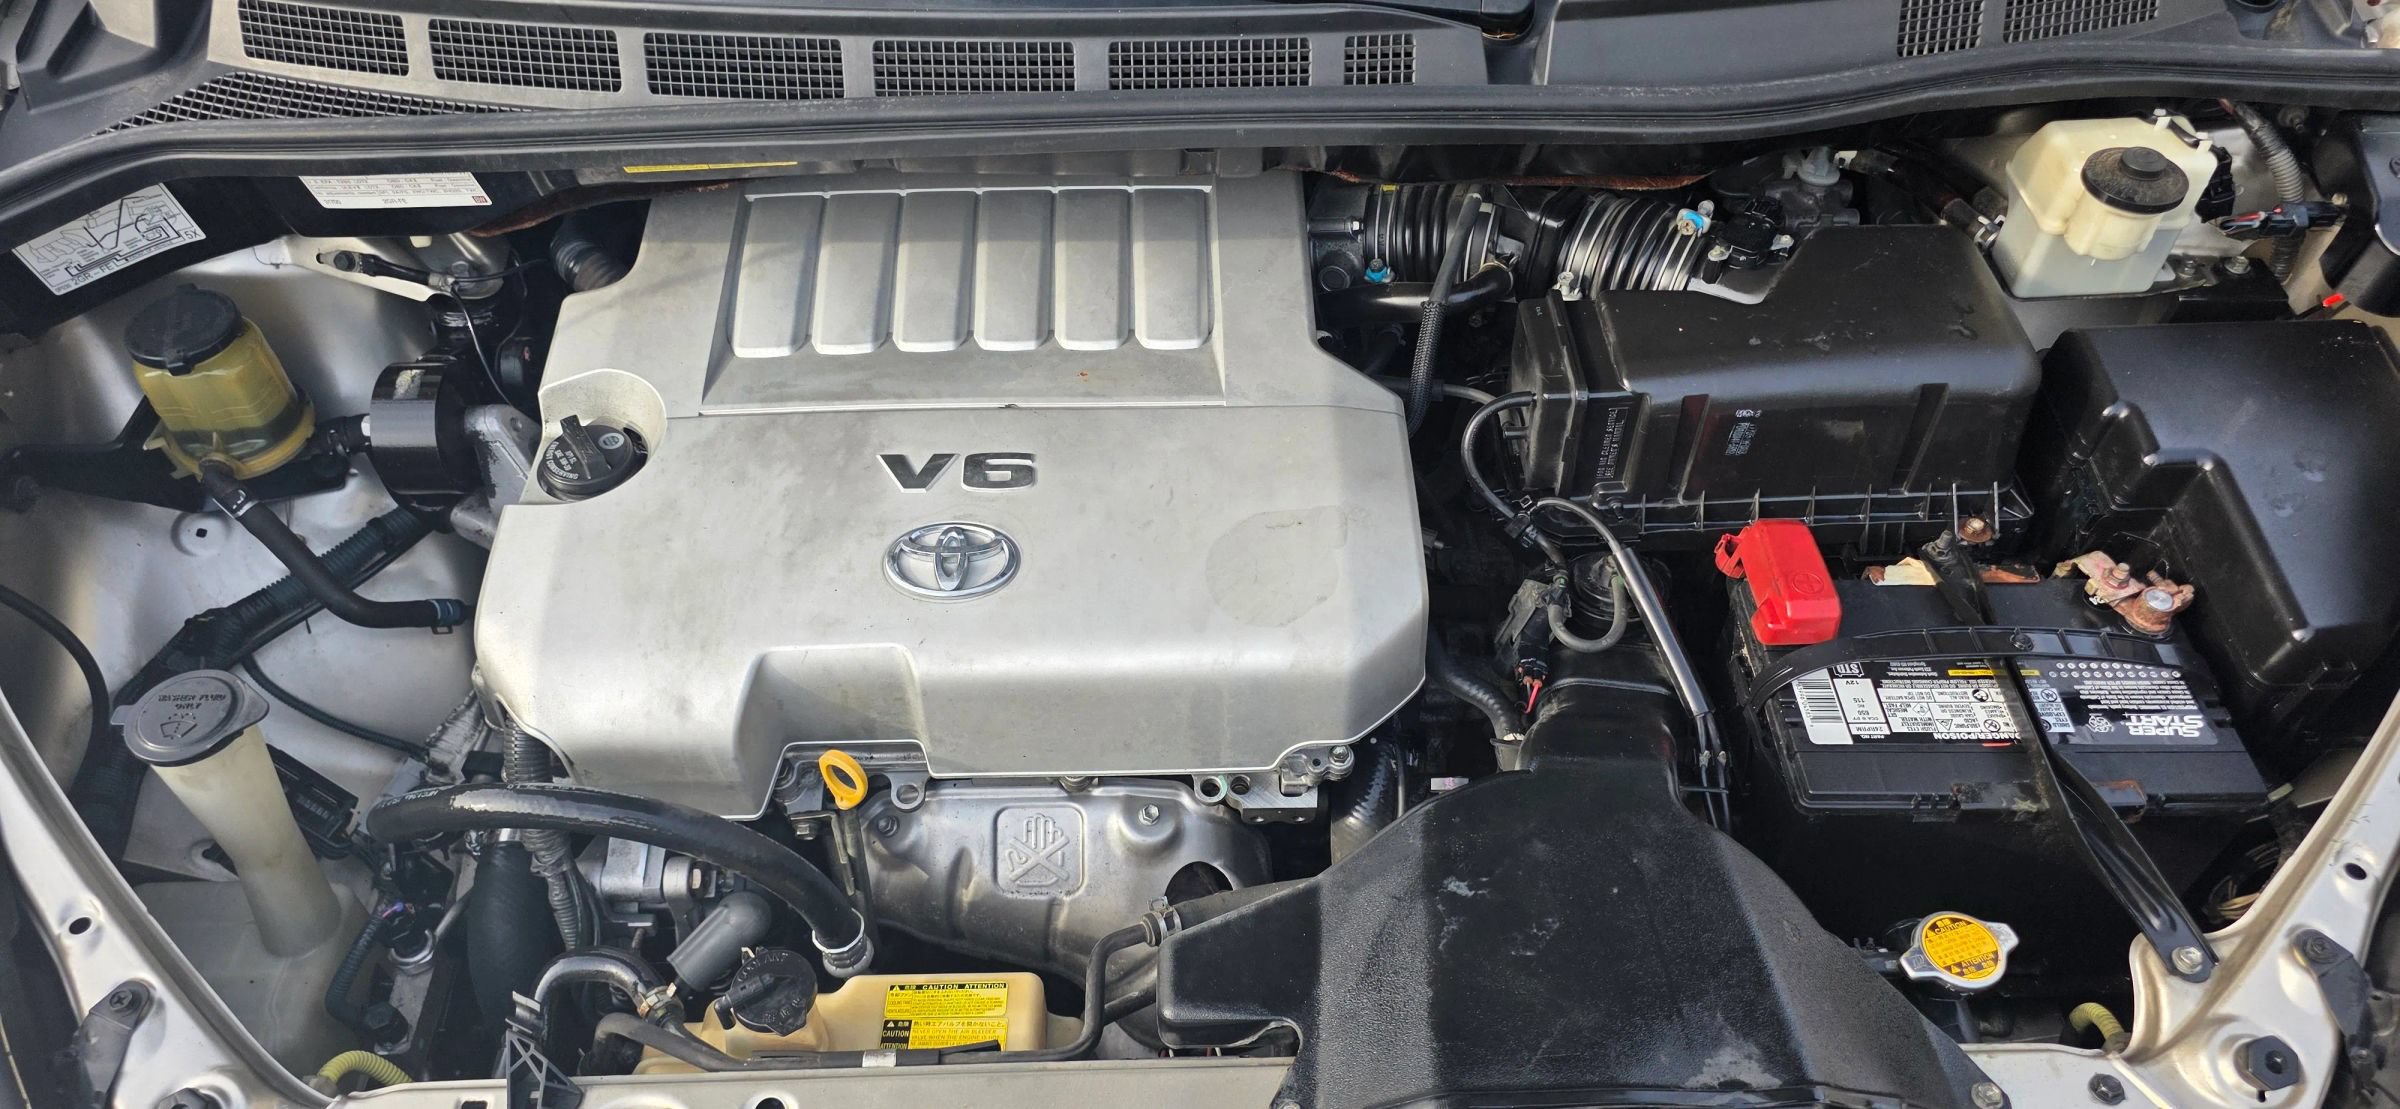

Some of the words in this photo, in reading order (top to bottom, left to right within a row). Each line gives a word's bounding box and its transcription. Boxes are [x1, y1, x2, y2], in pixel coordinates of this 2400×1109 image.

[184, 230, 202, 241] 5X
[546, 460, 579, 480] CONSERVING
[877, 452, 1037, 493] V6
[1836, 663, 1860, 674] STD
[2125, 715, 2204, 728] START
[2128, 726, 2201, 738] SUPER
[1934, 920, 1967, 935] CAUTION
[1961, 952, 1996, 969] ATTENTION
[882, 1030, 910, 1038] CAUTION
[880, 1042, 908, 1050] ATTENTION
